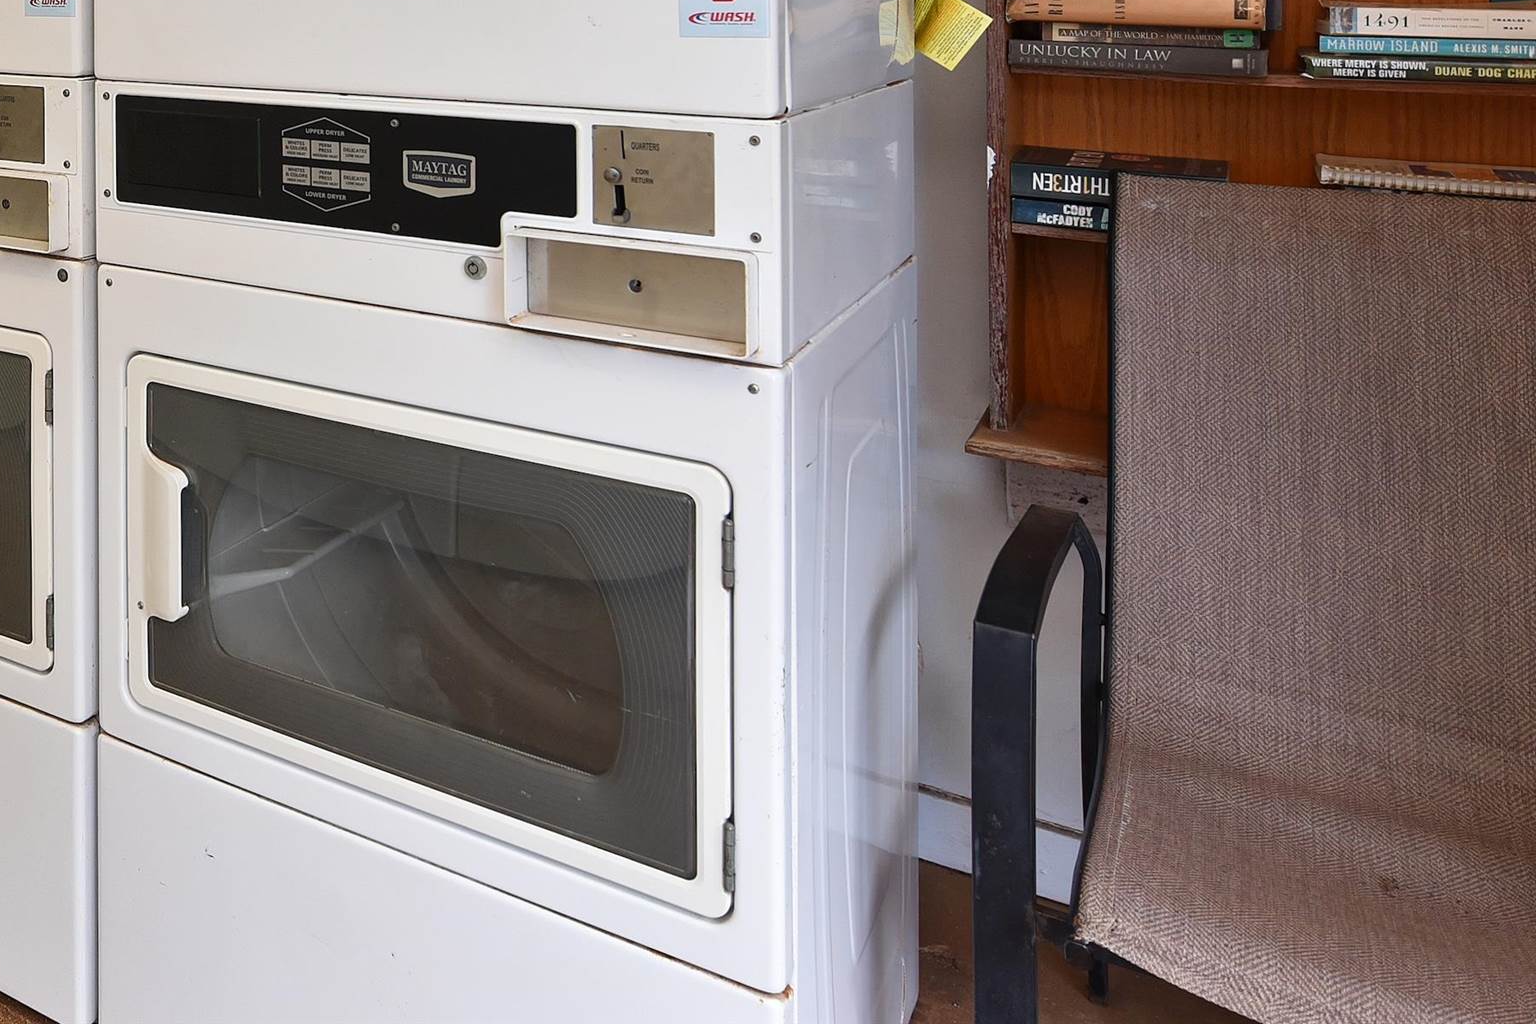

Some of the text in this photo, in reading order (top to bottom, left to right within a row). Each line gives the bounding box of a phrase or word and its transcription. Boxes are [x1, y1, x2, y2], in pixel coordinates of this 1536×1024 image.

[709, 12, 755, 23] WASH
[1363, 13, 1410, 30] 1491
[1067, 28, 1225, 43] MAP OF THE WORLD HAMILTON
[1326, 38, 1503, 54] MARROW ISLAND ALEXIS M.
[1019, 43, 1173, 63] UNLUCKY IN LAW
[1310, 58, 1429, 73] WHERE MERCY IS SHOWN,
[1433, 65, 1473, 78] DUANE
[1331, 67, 1407, 79] MERCY IS GIVEN
[304, 127, 345, 137] UPPER DRYER
[630, 141, 661, 152] QUARTERS
[411, 159, 469, 177] MAYTAG
[411, 172, 444, 182] COMMERCIAL
[630, 177, 654, 185] RETURN
[304, 190, 347, 202] LOWER DRYER
[1062, 203, 1095, 218] CODY
